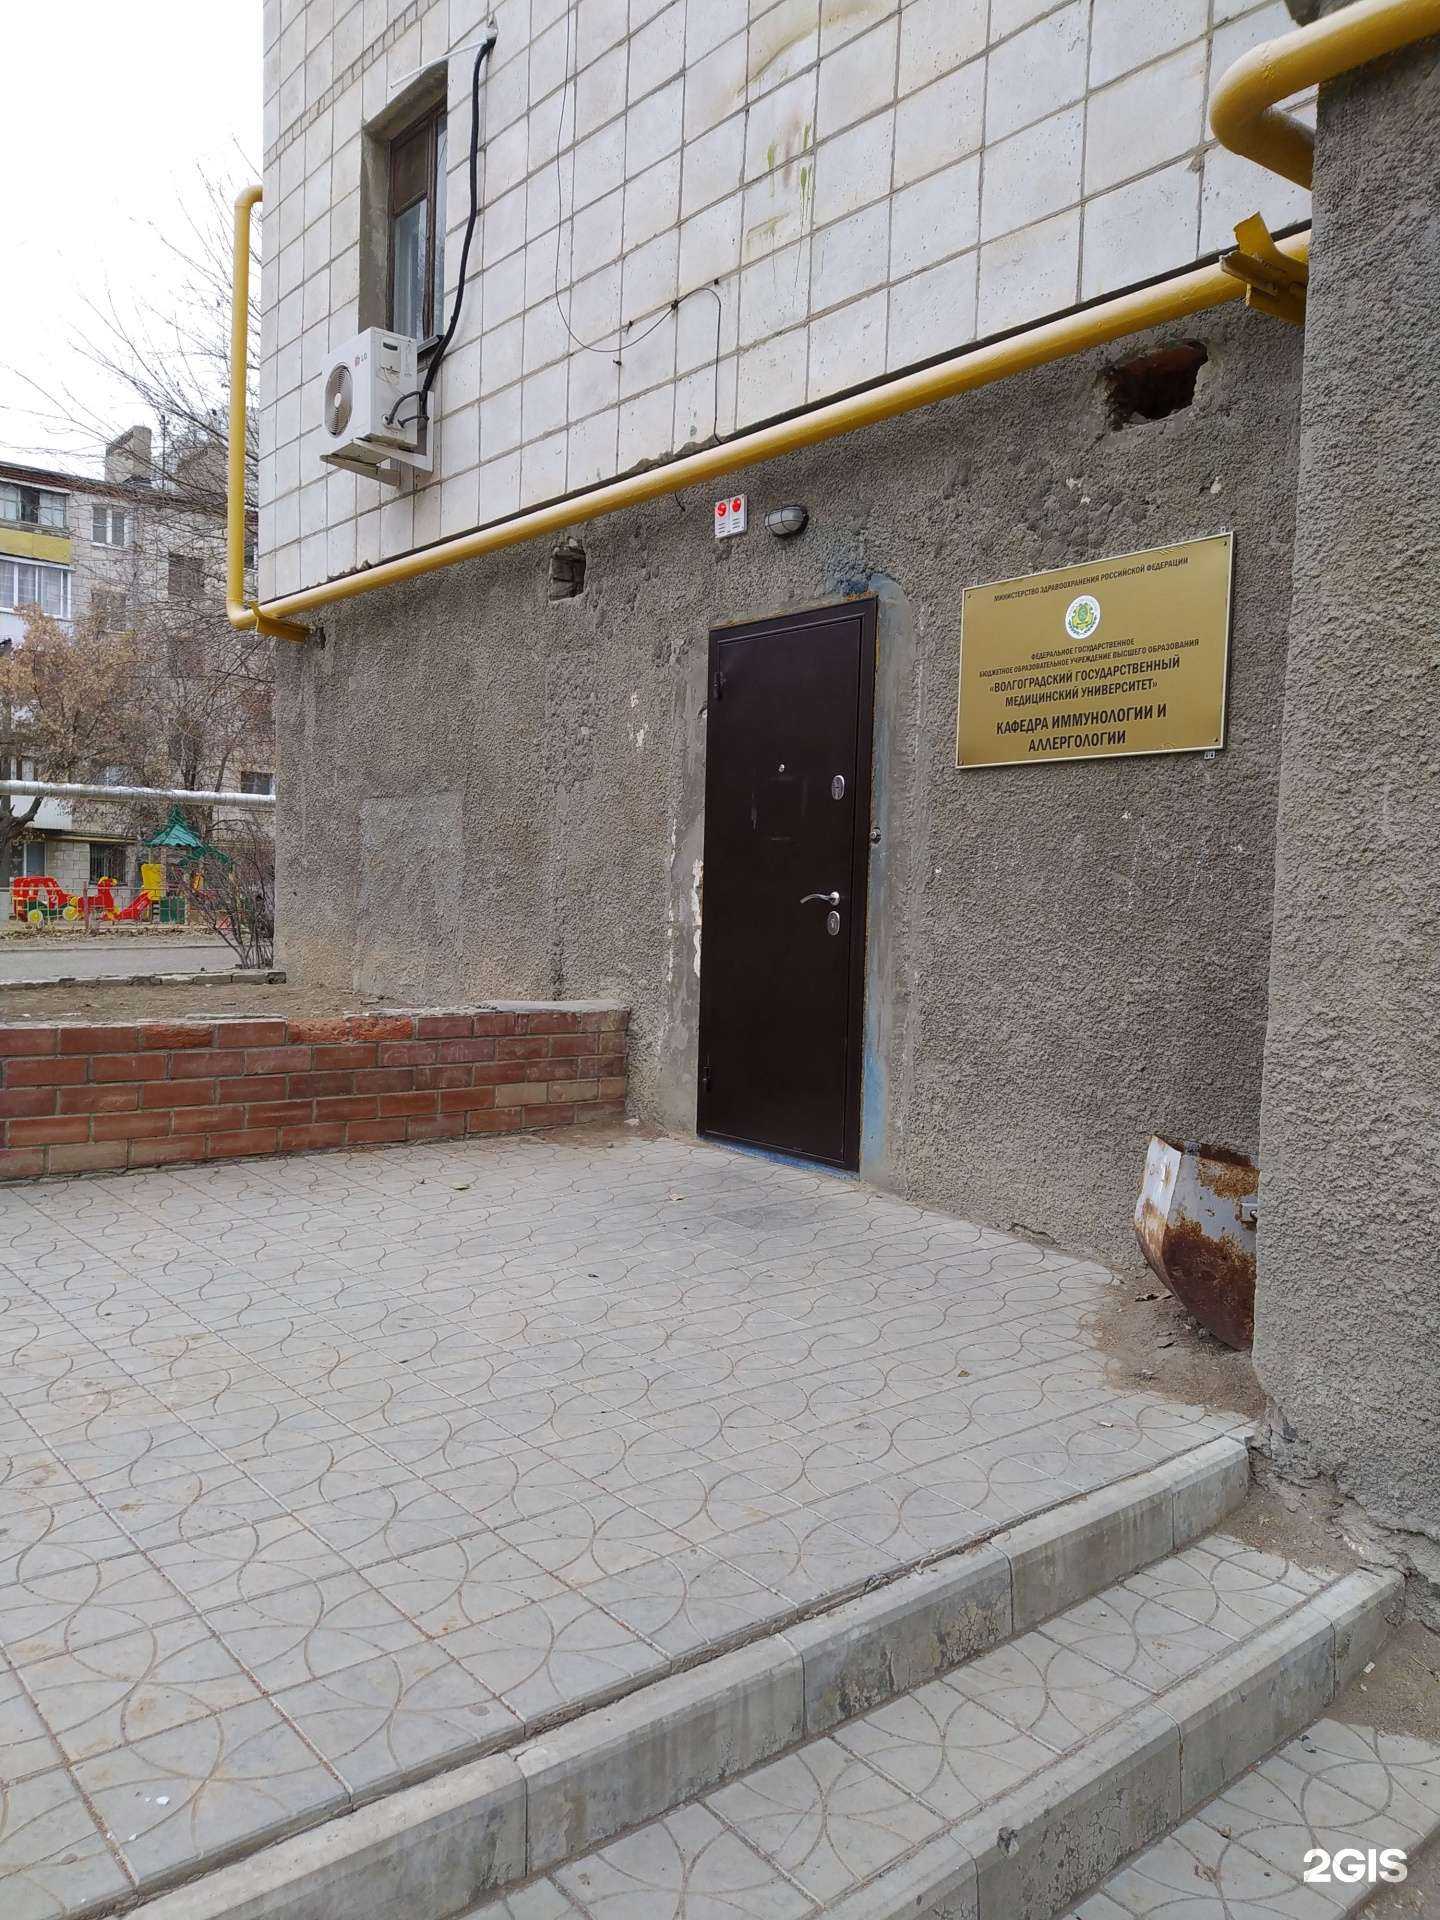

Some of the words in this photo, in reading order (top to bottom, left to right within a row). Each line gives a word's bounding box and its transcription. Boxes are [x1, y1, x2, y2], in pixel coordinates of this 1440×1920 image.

[993, 587, 1039, 601] МИНИСТЕРСТВО
[1040, 575, 1100, 594] ЗДРАВООХРАНЕНИЯ
[1100, 565, 1145, 582] РОССИЙСКОЙ
[1146, 557, 1188, 572] ФЕДЕРАЦИИ
[979, 665, 1013, 678] БЮДЖЕТНОЕ
[1013, 658, 1069, 673] ОБРАЗОВАТЕЛЬНОЕ
[1069, 652, 1112, 665] УЧРЕЖДЕНИЕ
[1112, 647, 1147, 659] ВЫСШЕГО
[1147, 638, 1200, 654] ОБРАЗОВАНИЯ
[1031, 647, 1074, 661] ФЕДЕРАЛЬНОЕ
[1074, 638, 1135, 654] ГОСУДАРСТВЕННОЕ
[989, 669, 1073, 693] «ВОЛГОГРАДСКИЙ
[1075, 655, 1180, 682] ГОСУДАРСТВЕННЫЙ
[1005, 685, 1079, 708] МЕДИЦИНСКИЙ
[1081, 678, 1158, 698] УНИВЕРСИТЕТ»
[996, 717, 1049, 735] КАФЕДРА
[1051, 705, 1153, 729] ИММУНОЛОГИИ
[1157, 703, 1167, 718] И
[1028, 730, 1126, 752] АЛЛЕРГОЛОГИИ
